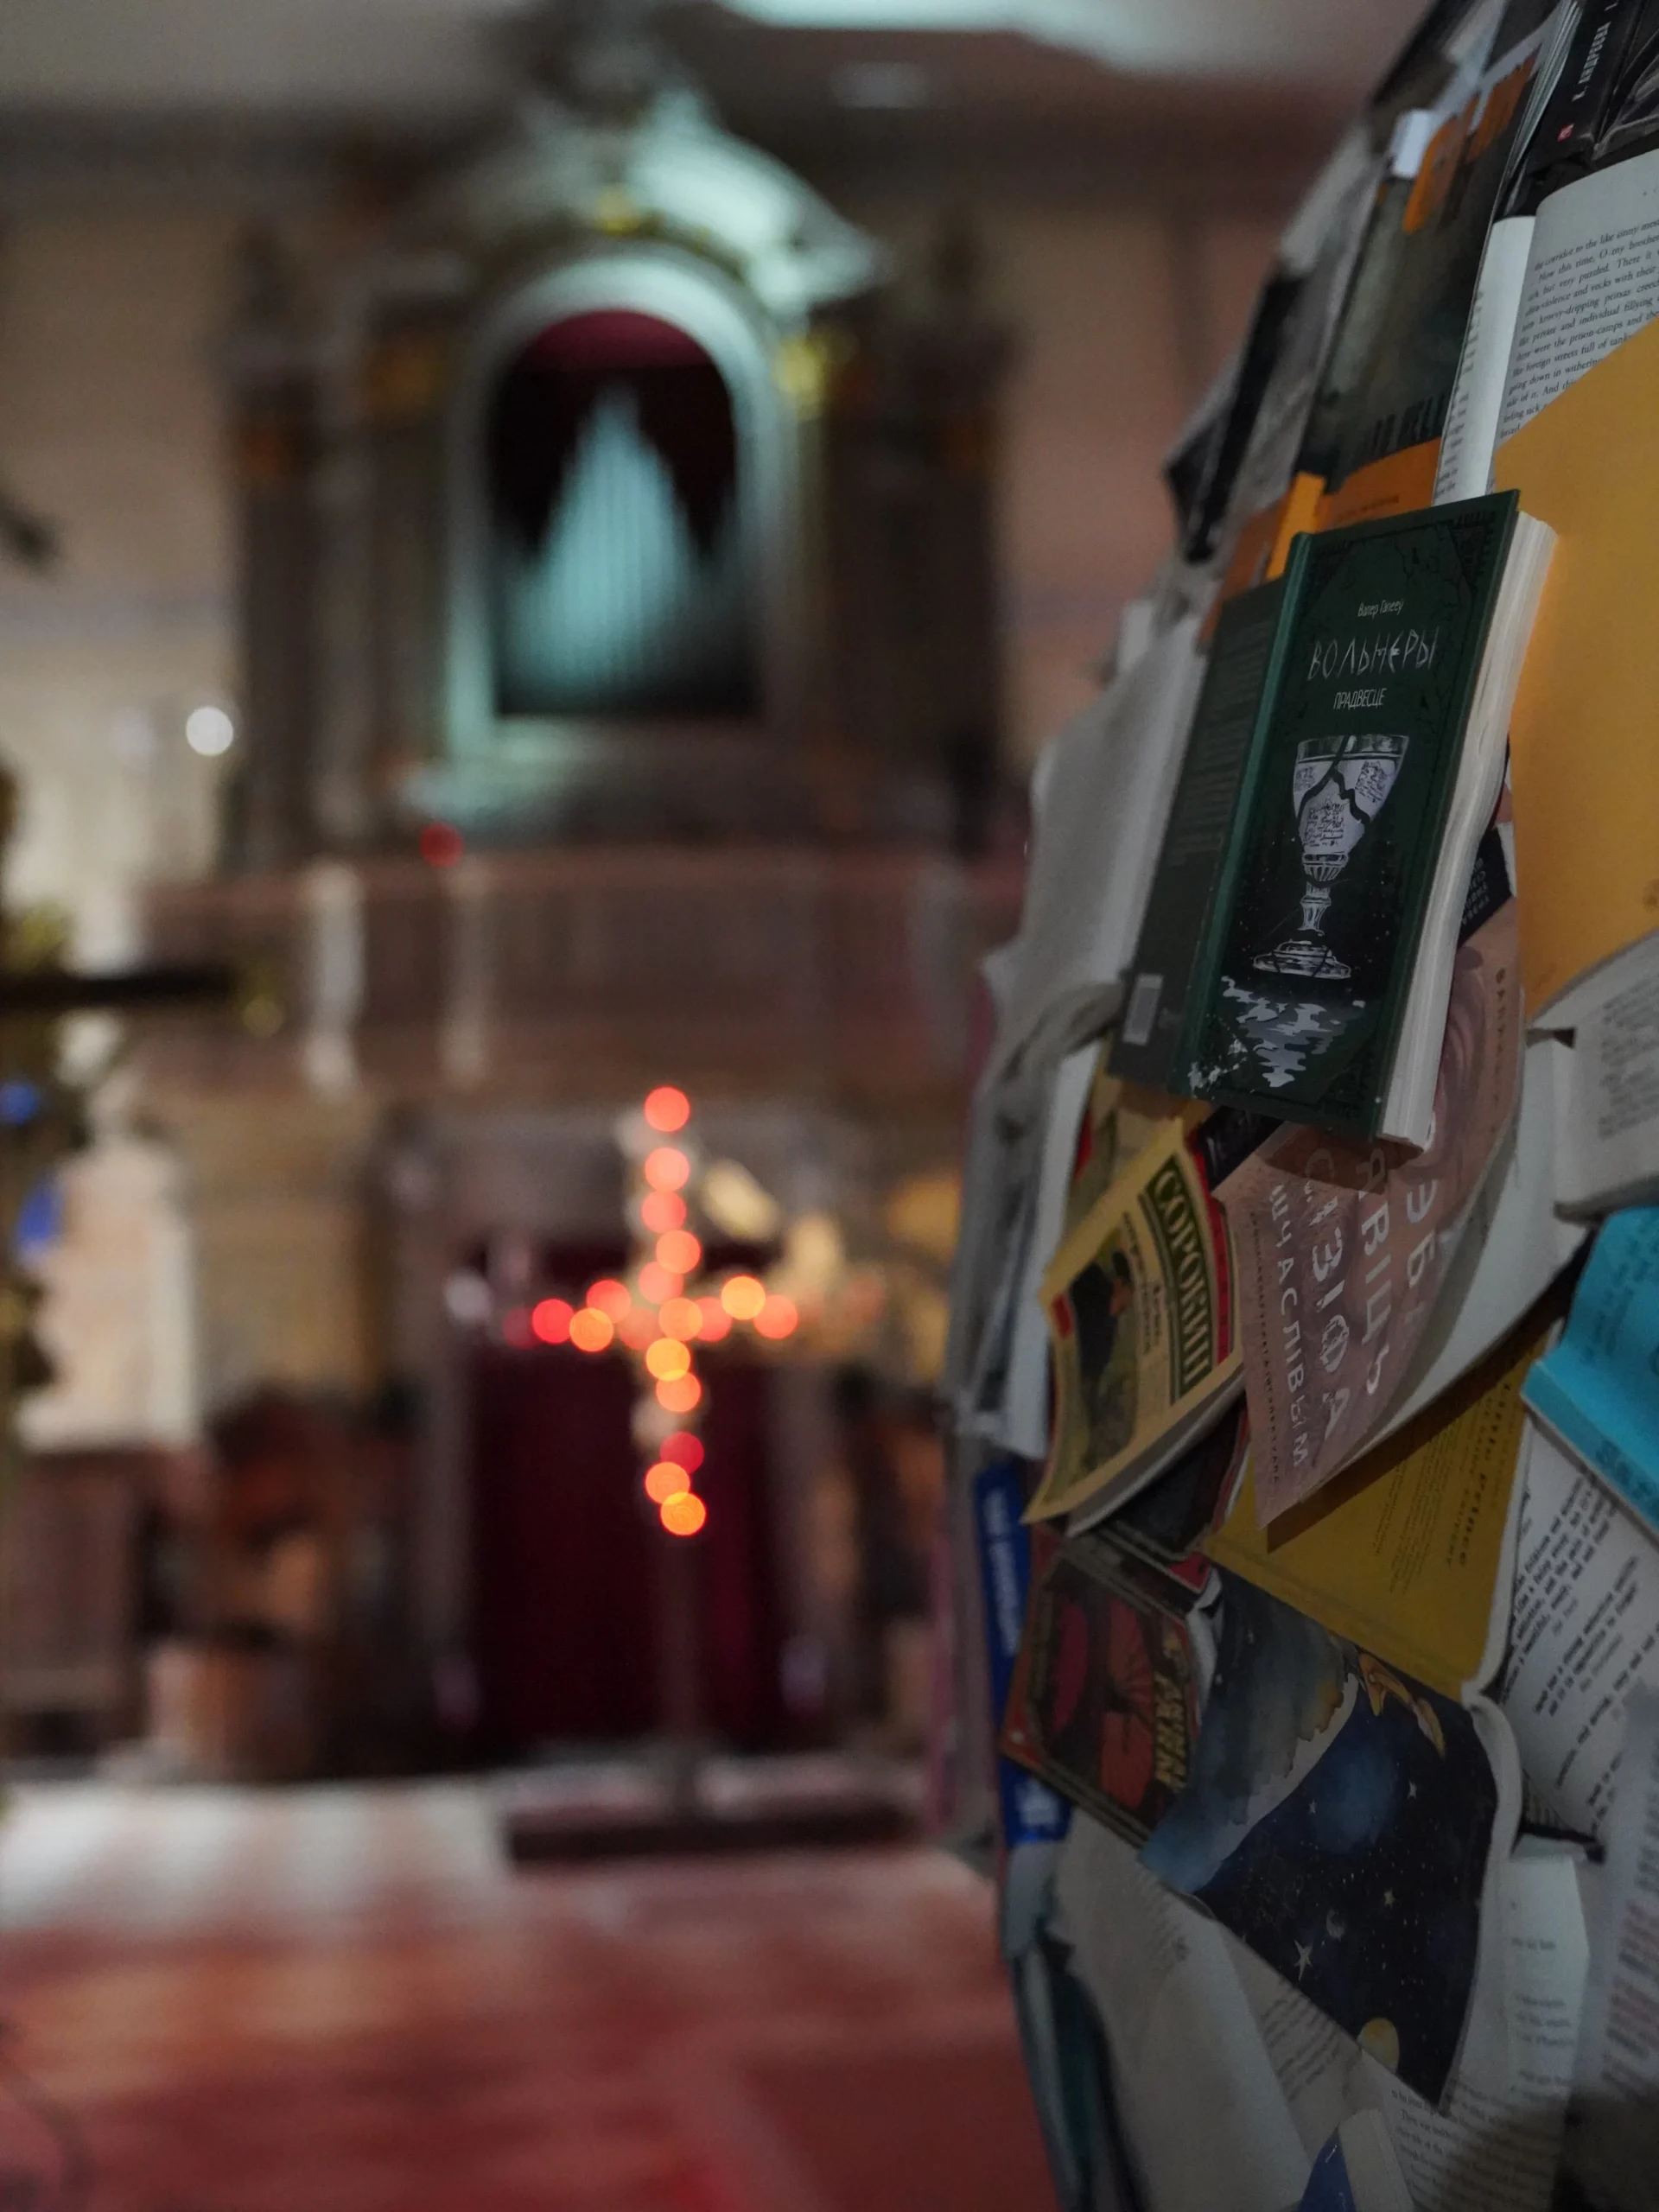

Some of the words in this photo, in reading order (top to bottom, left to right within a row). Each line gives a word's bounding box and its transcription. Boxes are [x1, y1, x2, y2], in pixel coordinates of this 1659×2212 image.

[1586, 238, 1597, 249] the
[1599, 232, 1614, 244] like
[1599, 249, 1608, 258] O
[1611, 245, 1625, 256] my
[1559, 278, 1574, 289] very
[1617, 257, 1641, 269] There
[1573, 283, 1589, 298] and
[1615, 270, 1633, 284] with
[1637, 266, 1657, 278] their
[1554, 336, 1567, 347] the
[1627, 312, 1643, 327] and
[1560, 317, 1576, 331] and
[1579, 304, 1620, 326] individual
[1526, 358, 1551, 372] foreign
[1580, 340, 1596, 354] full
[1598, 337, 1608, 349] of
[1520, 392, 1529, 403] of
[1542, 381, 1560, 397] And
[1529, 373, 1551, 385] down
[1553, 369, 1561, 378] in
[1306, 626, 1440, 682] ВОЛЬНЕРЫ
[1332, 688, 1388, 711] ПРАДВЕСЦЕ
[1154, 1167, 1211, 1386] СОРОКИН
[1269, 1181, 1310, 1468] ШЧАСЛІВЫМ
